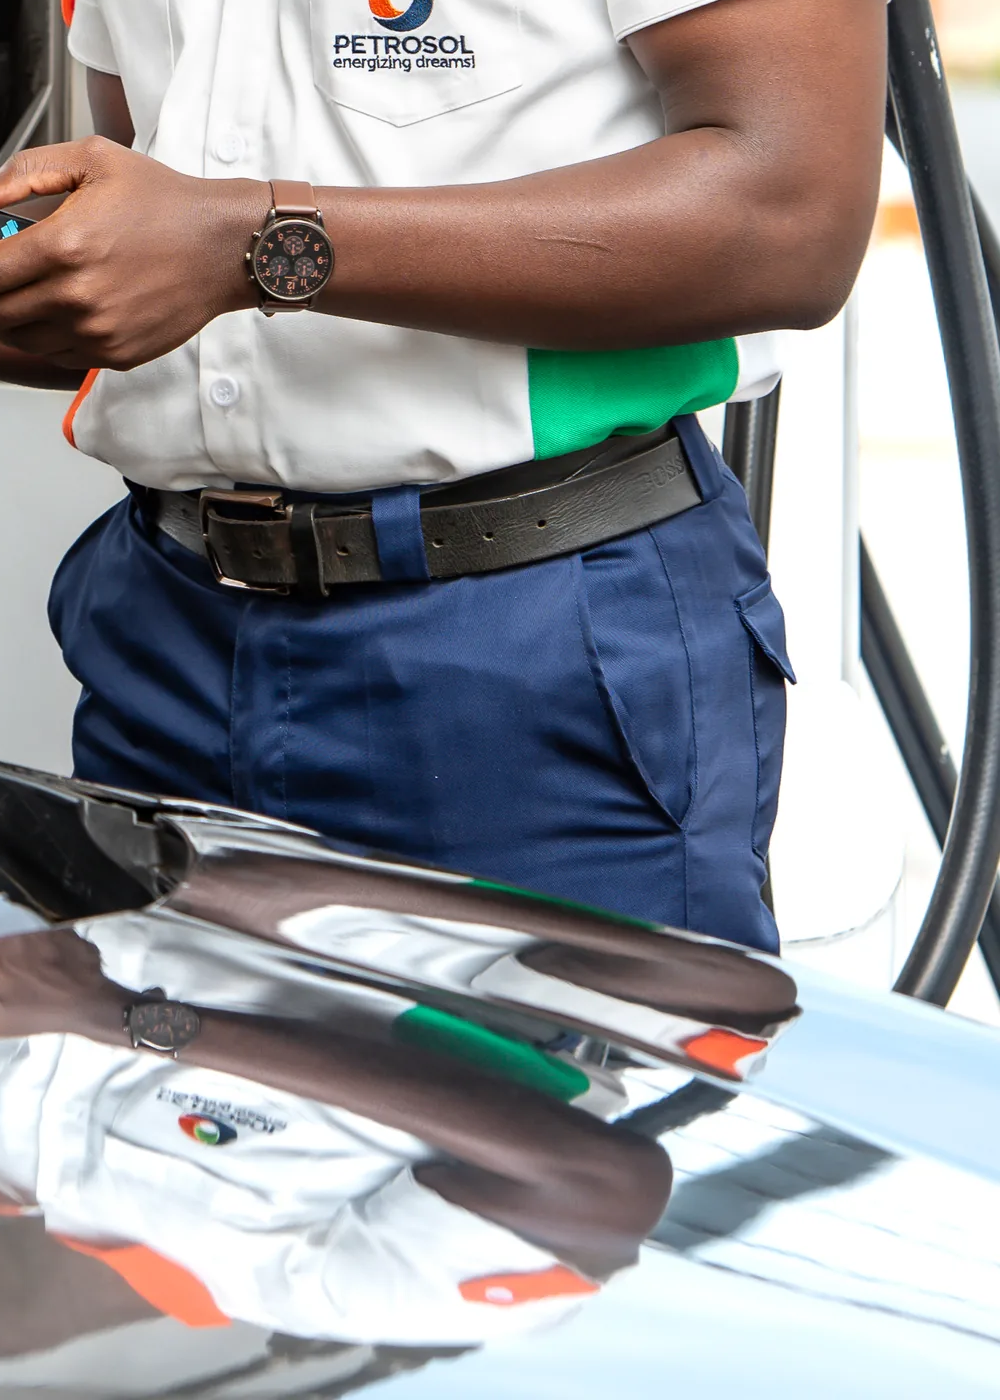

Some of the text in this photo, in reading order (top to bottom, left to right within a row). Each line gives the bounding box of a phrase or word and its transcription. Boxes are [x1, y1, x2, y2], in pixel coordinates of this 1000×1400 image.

[333, 34, 474, 55] PETROSOL
[333, 55, 476, 73] energizing dreams!
